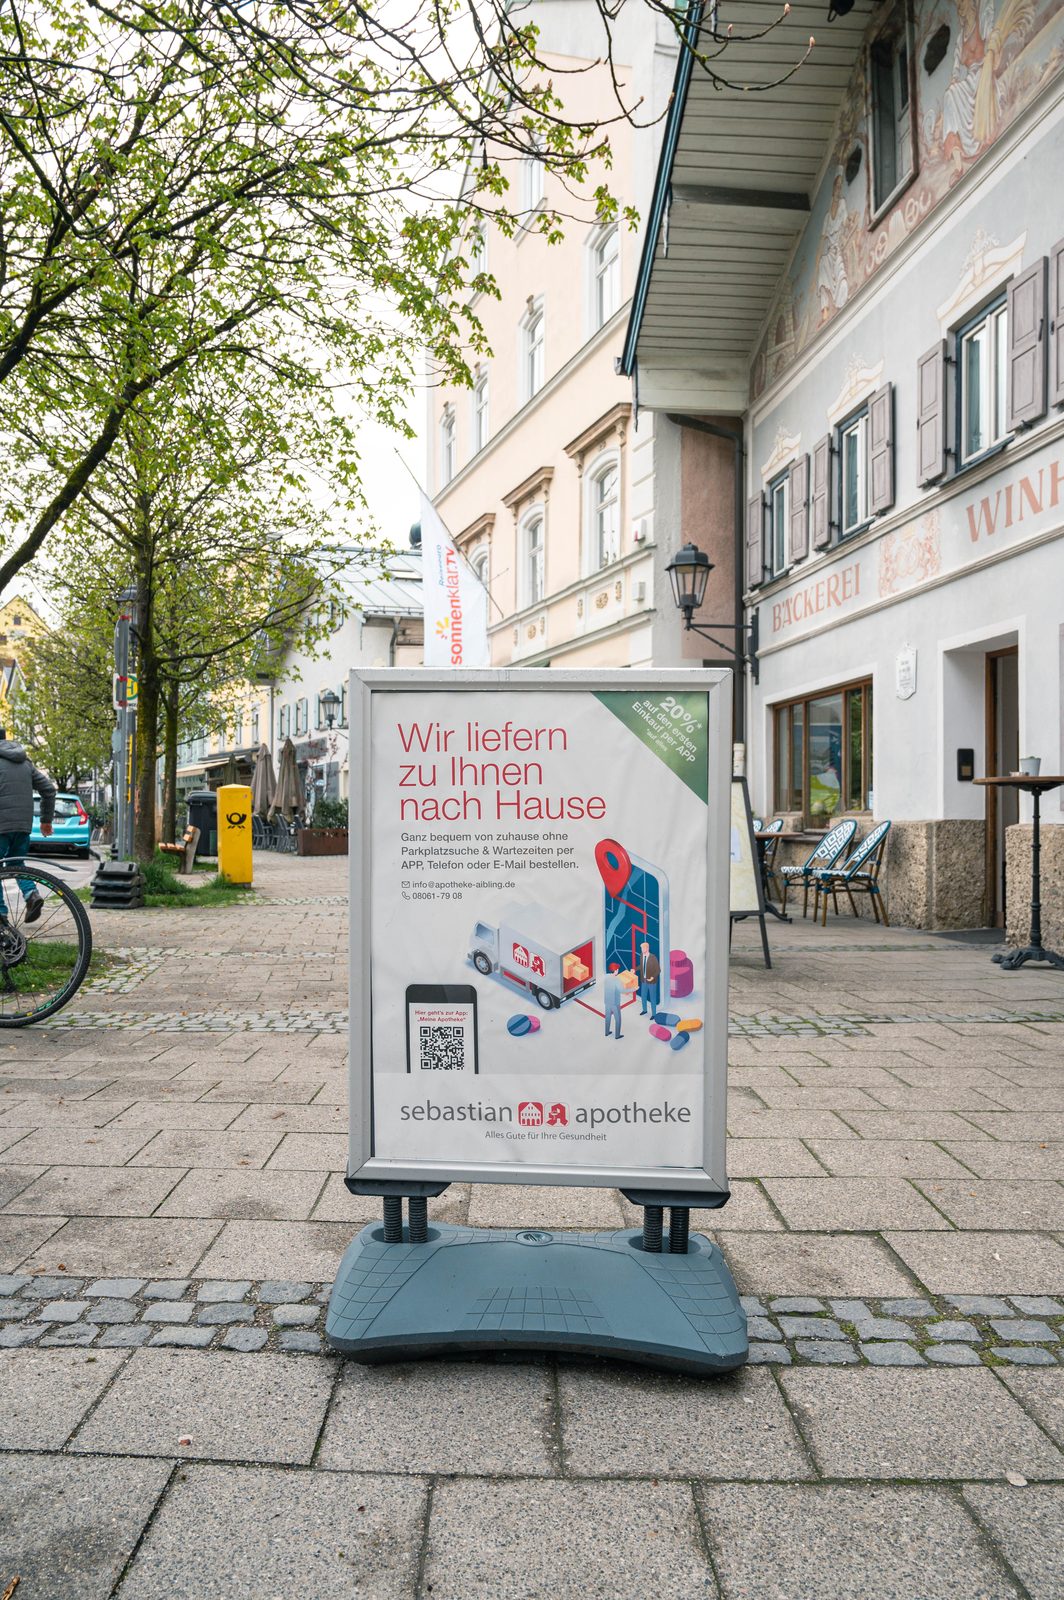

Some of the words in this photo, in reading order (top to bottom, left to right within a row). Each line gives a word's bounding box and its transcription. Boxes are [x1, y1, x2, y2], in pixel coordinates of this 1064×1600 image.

[772, 563, 860, 632] BÄCKEREI
[397, 722, 456, 753] Wir
[467, 721, 567, 752] liefern
[632, 701, 664, 732] Einkauf
[661, 732, 677, 747] per
[676, 746, 696, 762] APP
[643, 700, 659, 714] auf
[657, 712, 672, 728] den
[672, 728, 697, 752] ersten
[399, 764, 436, 787] zu
[451, 756, 543, 786] Ihnen
[400, 790, 482, 821] nach
[496, 790, 606, 821] Hause
[401, 832, 427, 842] Ganz
[430, 832, 472, 844] bequem
[496, 832, 539, 841] zuhause
[542, 832, 568, 841] ohne
[401, 846, 479, 858] Parkplatzsuche
[482, 846, 490, 855] &
[492, 845, 554, 855] Wartezeiten
[556, 847, 574, 857] per
[401, 861, 424, 871] APP,
[427, 860, 464, 870] Telefon
[466, 860, 490, 870] oder
[493, 860, 526, 869] E-Mail
[529, 859, 579, 869] bestellen.
[412, 880, 516, 891] info@apotheke-aibling.de
[452, 892, 463, 900] 08
[400, 1100, 513, 1123] sebastian
[575, 1101, 692, 1129] apotheke
[485, 1131, 504, 1140] Alles
[505, 1132, 526, 1140] Gute
[527, 1131, 540, 1140] für
[541, 1132, 557, 1141] Ihre
[558, 1132, 607, 1142] Gesundheit
